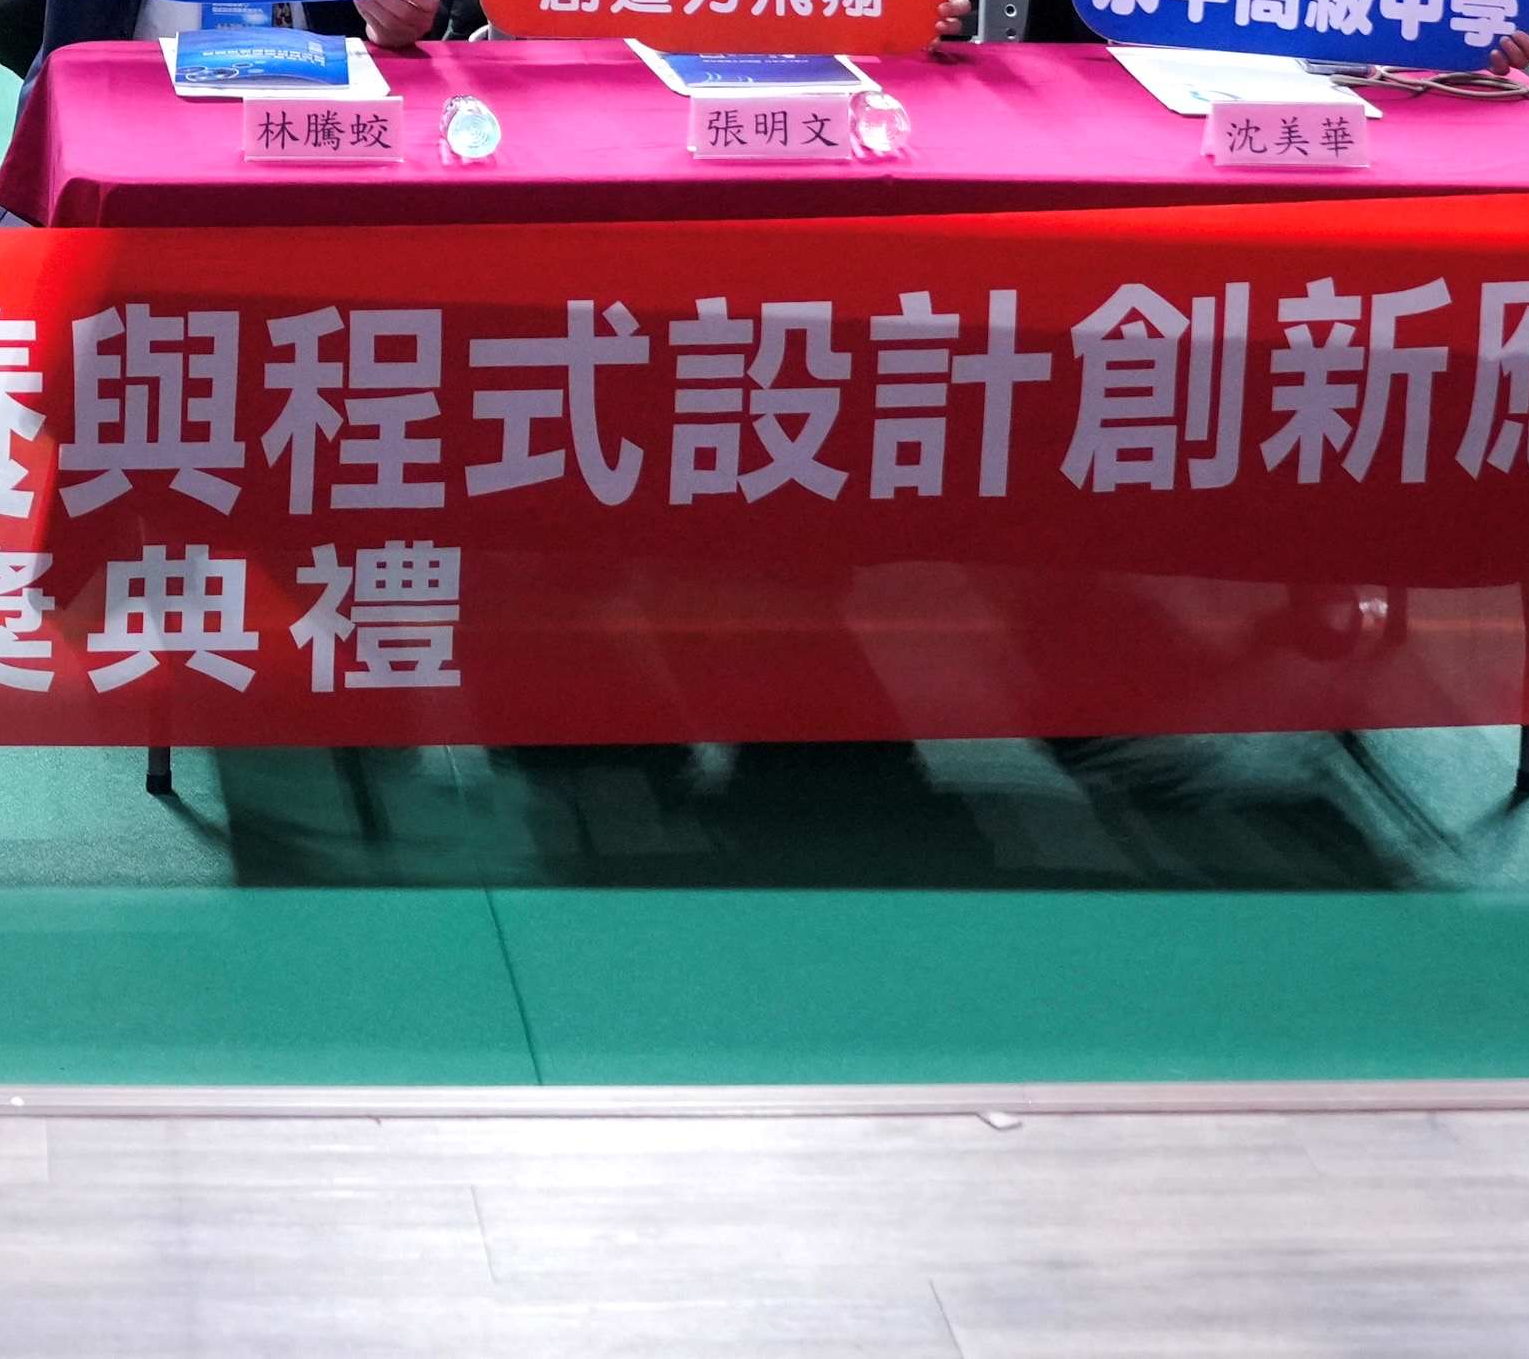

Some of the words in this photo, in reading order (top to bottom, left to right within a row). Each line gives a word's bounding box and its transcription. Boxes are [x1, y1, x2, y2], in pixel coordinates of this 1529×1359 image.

[256, 109, 392, 151] 林騰蛟
[707, 110, 840, 149] 張明文
[1225, 117, 1356, 159] 沈美華
